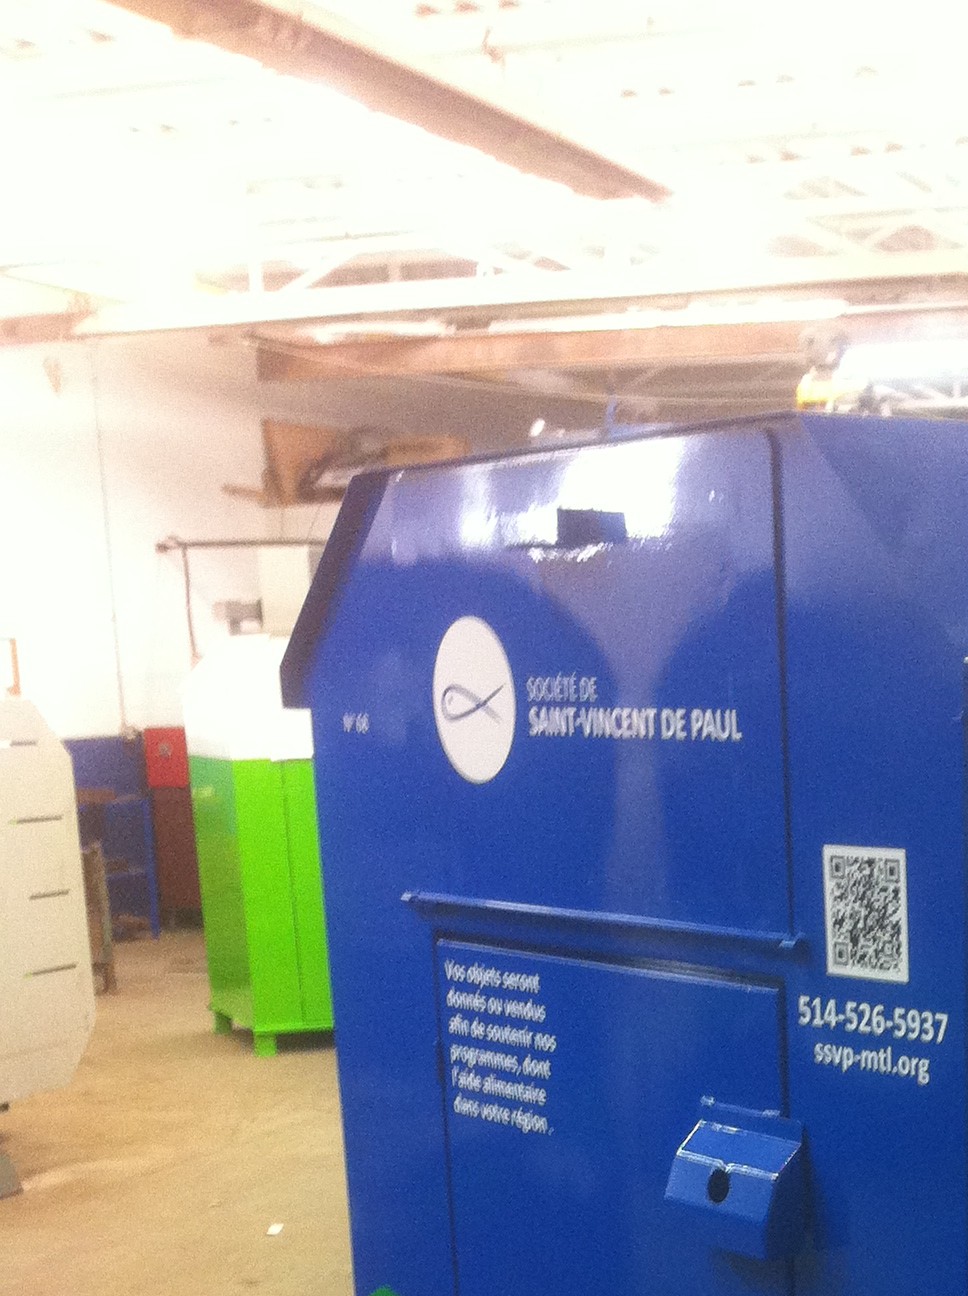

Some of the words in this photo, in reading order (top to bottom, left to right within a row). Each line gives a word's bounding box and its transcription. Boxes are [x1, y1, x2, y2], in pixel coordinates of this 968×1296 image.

[526, 672, 578, 702] SOCIÉTÉ
[579, 676, 598, 702] DE
[529, 705, 657, 739] SAINT-VINCENT
[660, 707, 687, 740] DE
[691, 708, 742, 742] PAUL
[444, 959, 466, 982] Vos
[466, 962, 502, 988] objets
[502, 970, 540, 994] seront
[447, 986, 487, 1012] donnés
[487, 996, 503, 1015] ou
[504, 999, 546, 1022] vendus
[798, 995, 949, 1044] 514-526-5937
[449, 1013, 470, 1037] afin
[470, 1017, 486, 1040] de
[486, 1022, 533, 1047] soutenir
[534, 1031, 557, 1053] nos
[522, 1055, 552, 1080] dont
[813, 1042, 931, 1086] ssvp-mtl.org
[482, 1073, 547, 1106] alimentaire
[453, 1093, 480, 1118] dans
[480, 1102, 510, 1125] votre
